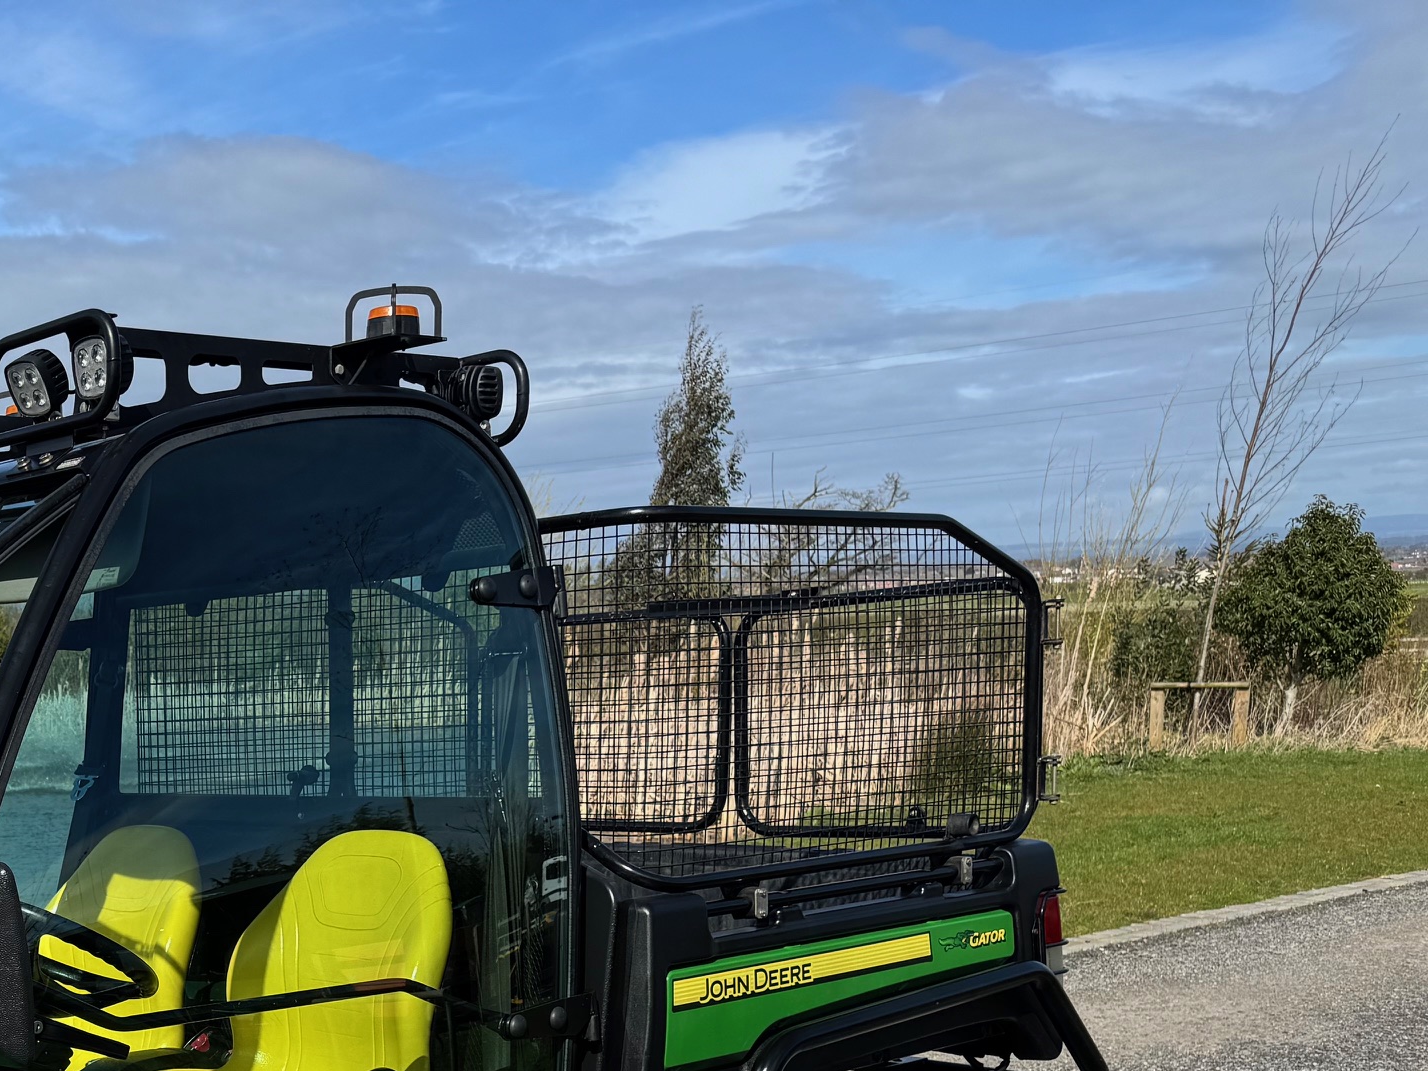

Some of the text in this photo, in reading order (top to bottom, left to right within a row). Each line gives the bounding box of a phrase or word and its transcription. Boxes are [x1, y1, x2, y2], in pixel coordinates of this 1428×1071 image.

[969, 928, 1005, 948] GATOR
[699, 962, 812, 1002] JOHN DEERE
